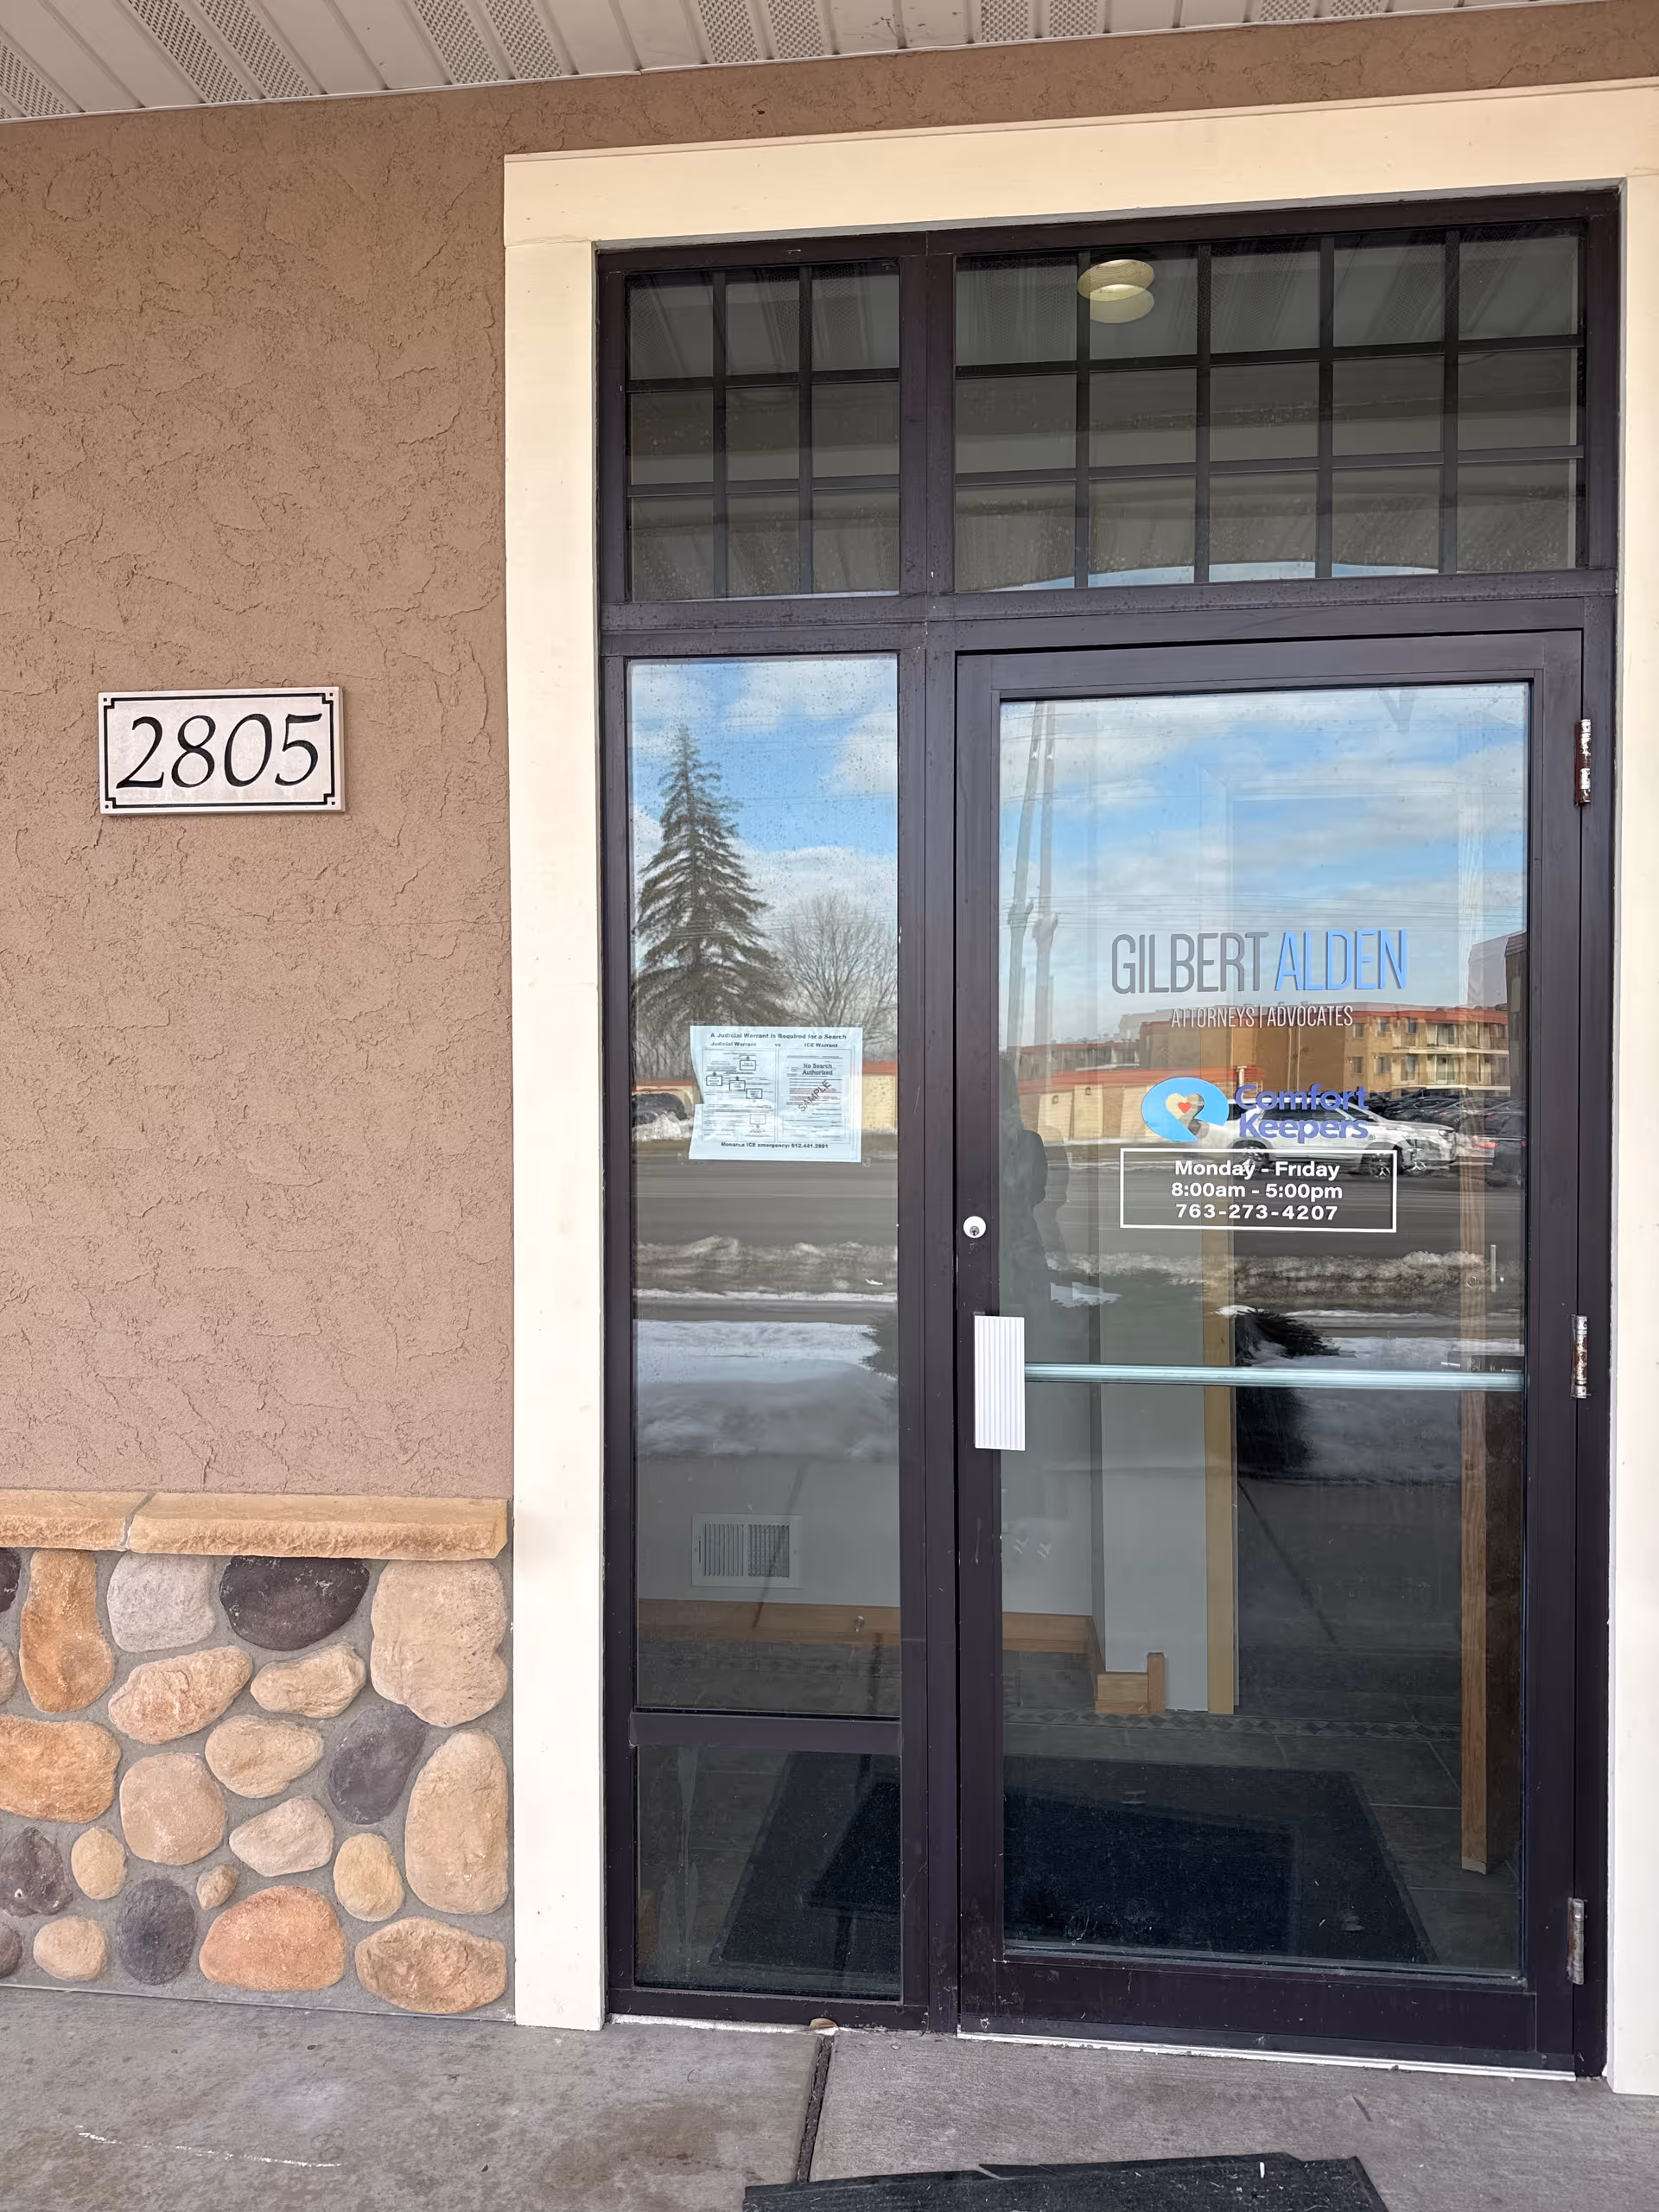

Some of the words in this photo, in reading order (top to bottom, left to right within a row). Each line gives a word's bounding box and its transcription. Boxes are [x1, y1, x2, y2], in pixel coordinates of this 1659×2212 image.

[116, 713, 322, 789] 2805
[1111, 932, 1268, 995] GILBERT
[1274, 928, 1408, 991] ALDEN
[1171, 1007, 1255, 1027] ATTORNEYS
[1267, 1005, 1353, 1027] ADVOCATES
[798, 1079, 832, 1112] SAMPLE
[1235, 1084, 1370, 1111] Comfort
[1175, 1160, 1255, 1179] Monday
[1274, 1161, 1340, 1181] Friday
[1171, 1182, 1246, 1198] 8:00am
[1265, 1183, 1343, 1201] 5:00pm
[1175, 1203, 1338, 1221] 763-273-4207
